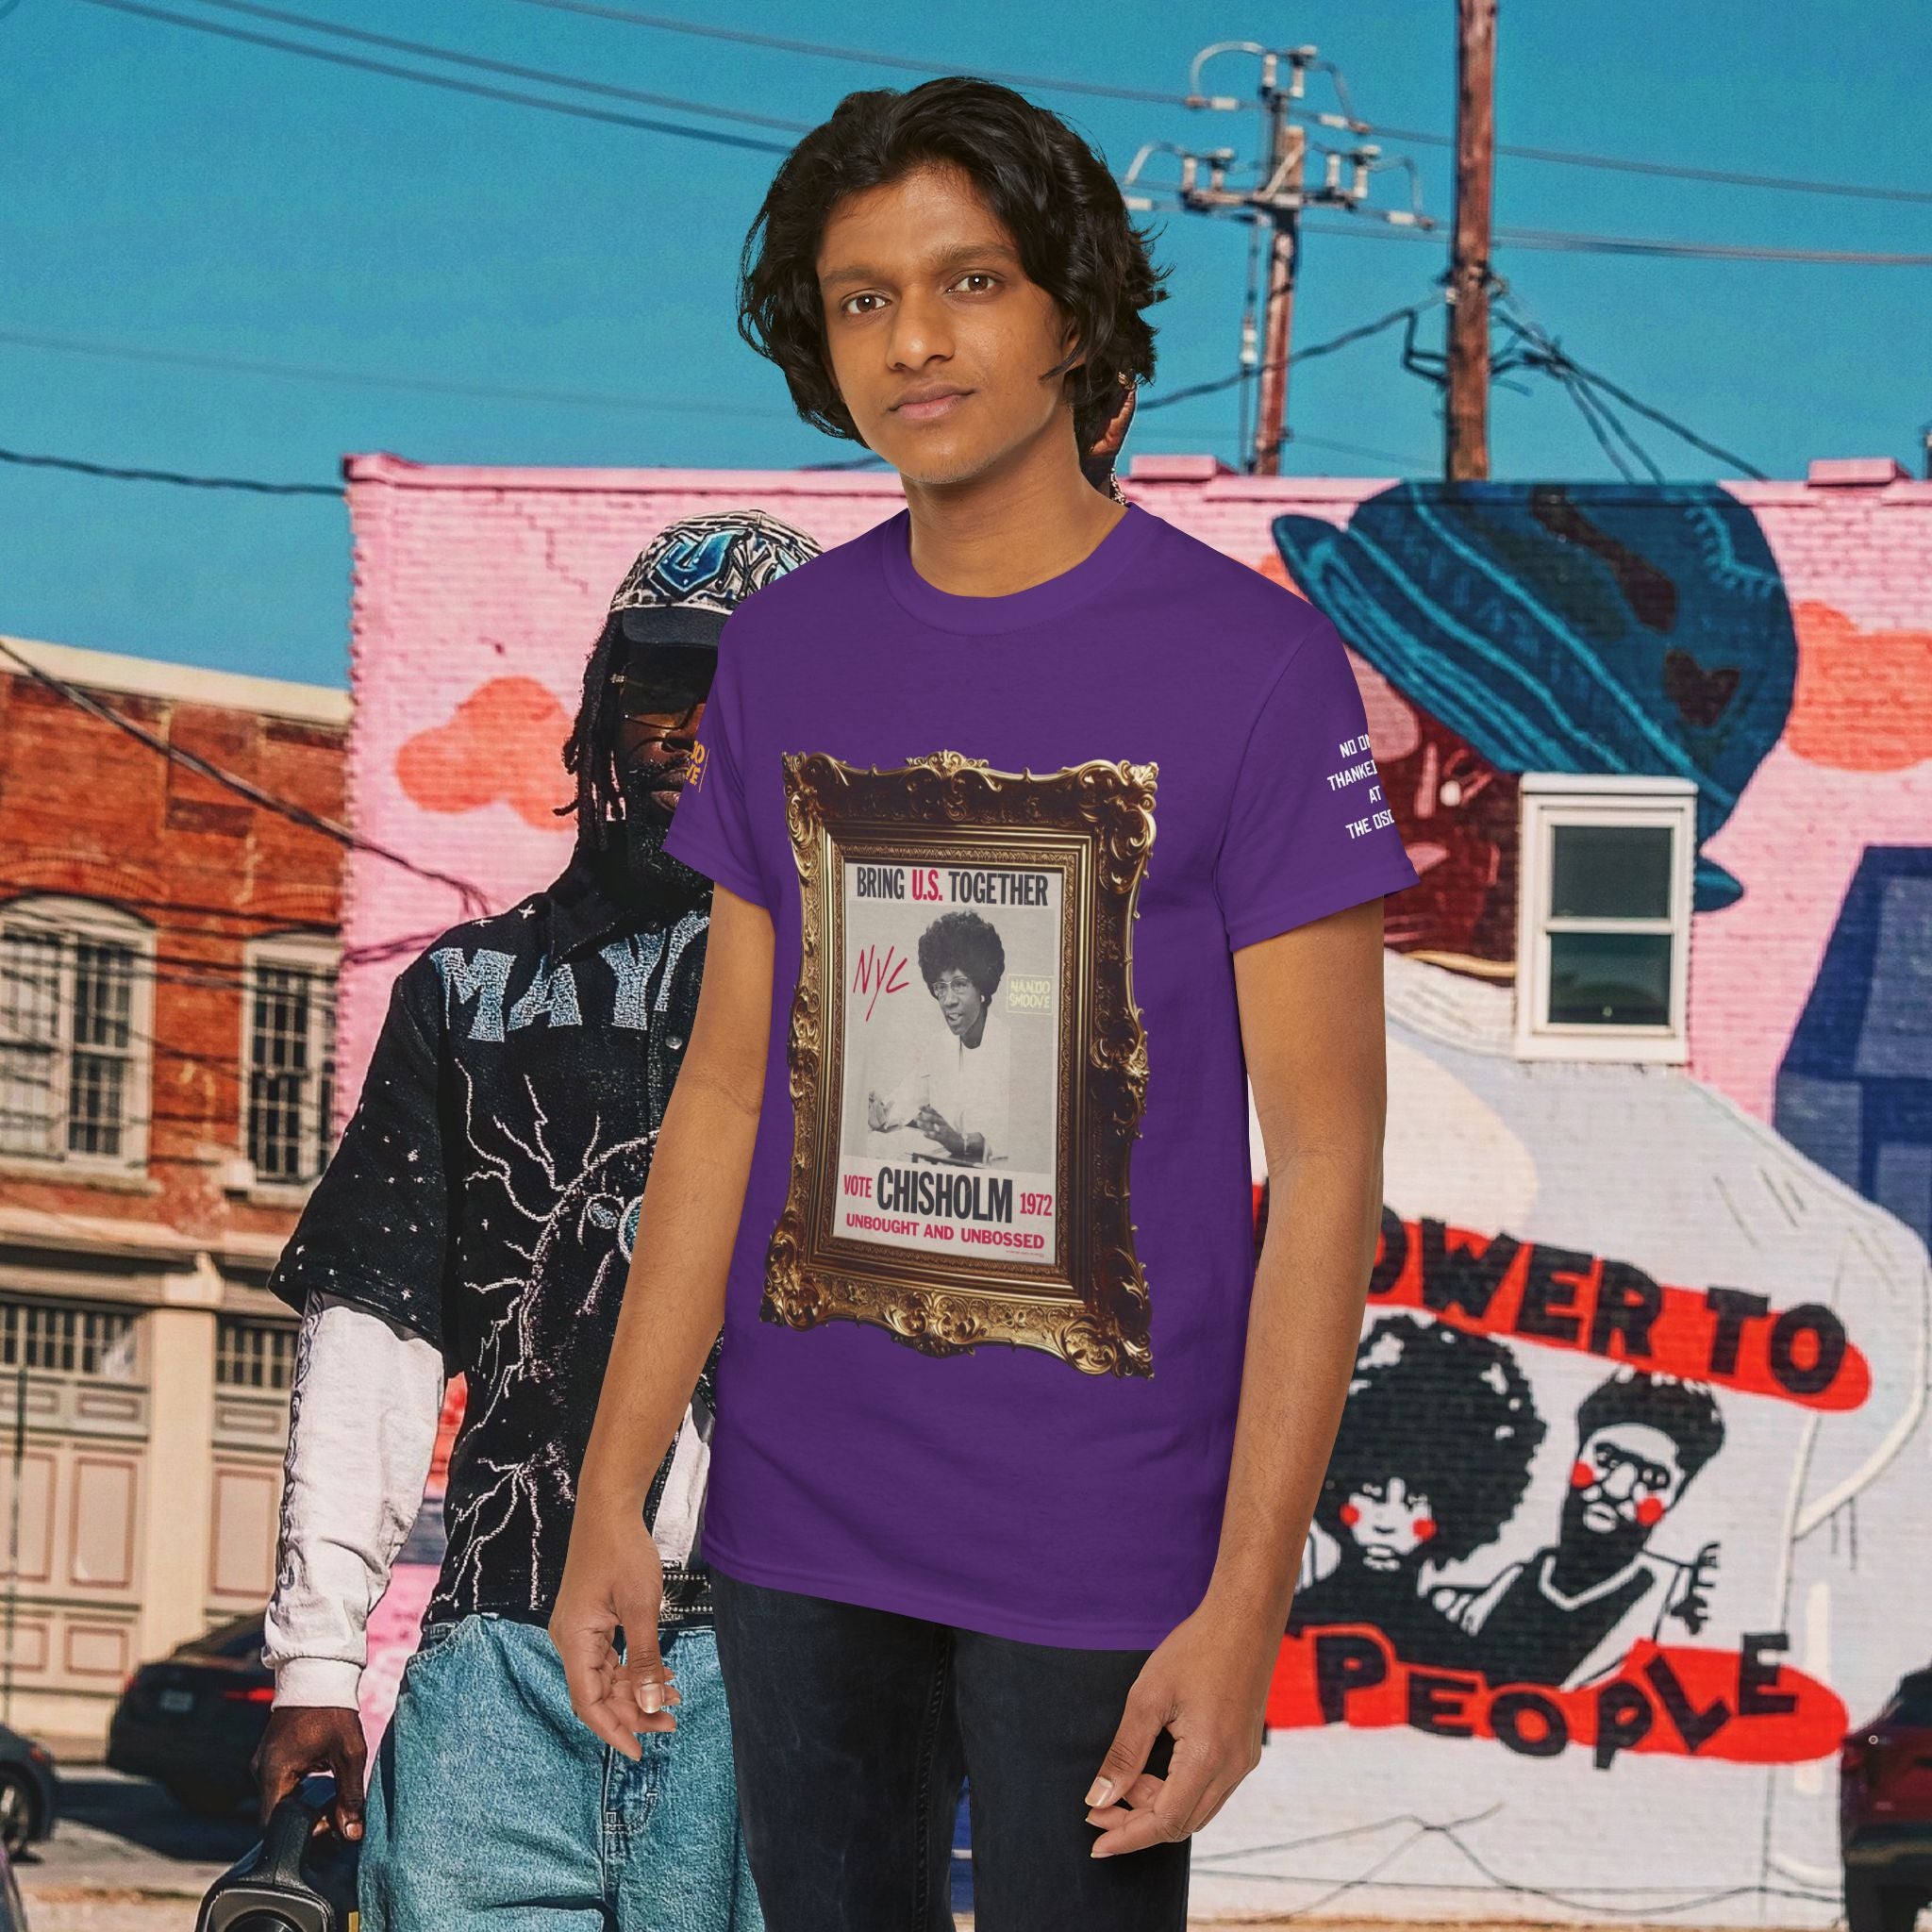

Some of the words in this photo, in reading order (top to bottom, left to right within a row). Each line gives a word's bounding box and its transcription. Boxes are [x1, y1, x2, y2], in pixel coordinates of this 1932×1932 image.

[1340, 740, 1357, 758] NO
[1369, 785, 1382, 804] AT
[1345, 818, 1372, 840] THE
[857, 867, 906, 900] BRING
[911, 868, 943, 902] U.S.
[948, 870, 1049, 906] TOGETHER
[853, 944, 909, 1022] NYC
[844, 1174, 873, 1198] VOTE
[877, 1166, 1013, 1224] CHISHOLM
[1020, 1192, 1053, 1217] 1972
[846, 1213, 920, 1237] UNBOUGHT
[924, 1224, 954, 1241] AND
[960, 1227, 1045, 1250] UNBOSSED
[1369, 1204, 1662, 1357] OWER
[1707, 1287, 1847, 1395] TO
[1315, 1633, 1798, 1770] PEOPLE
